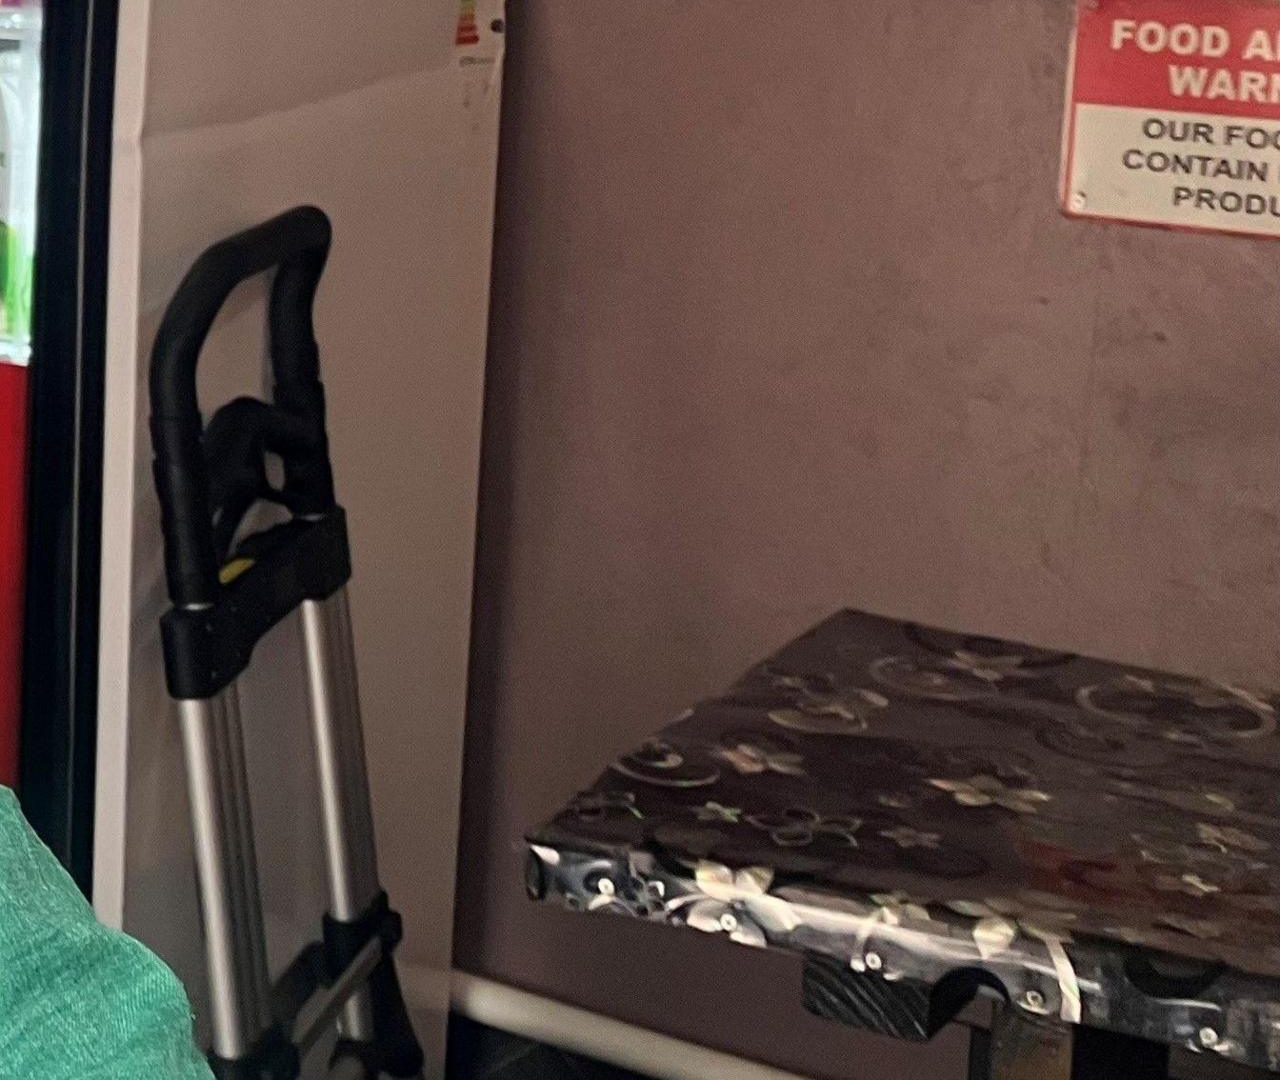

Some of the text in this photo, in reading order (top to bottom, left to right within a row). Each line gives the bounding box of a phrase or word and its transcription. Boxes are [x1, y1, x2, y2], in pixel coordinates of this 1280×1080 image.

[1110, 19, 1280, 62] FOOD A
[1142, 117, 1214, 145] OUR
[1122, 149, 1268, 183] CONTAIN
